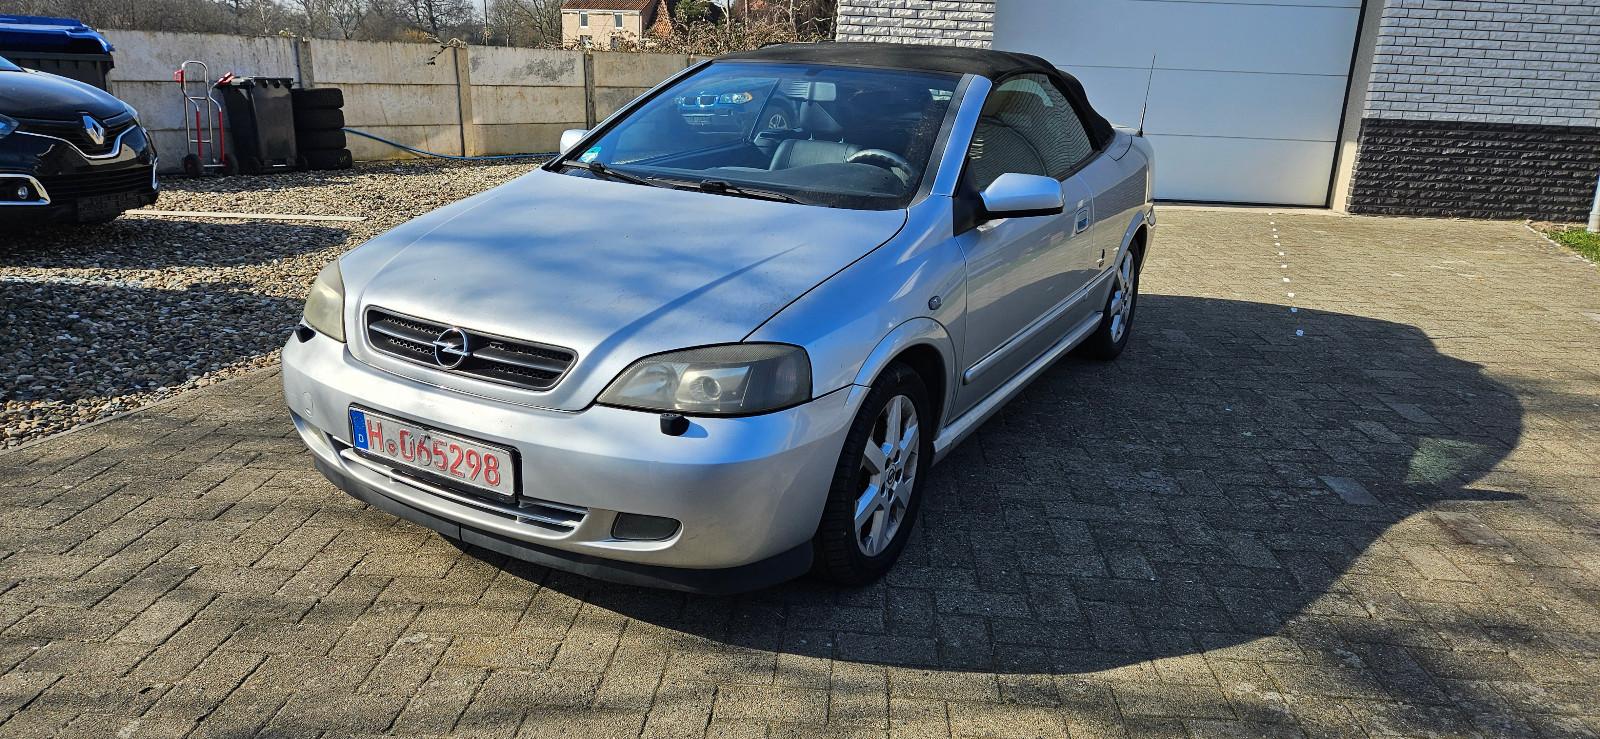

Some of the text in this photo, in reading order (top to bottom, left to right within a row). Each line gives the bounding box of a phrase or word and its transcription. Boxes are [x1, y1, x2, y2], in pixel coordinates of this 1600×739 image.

[358, 433, 364, 443] D
[367, 419, 500, 487] H 065298
